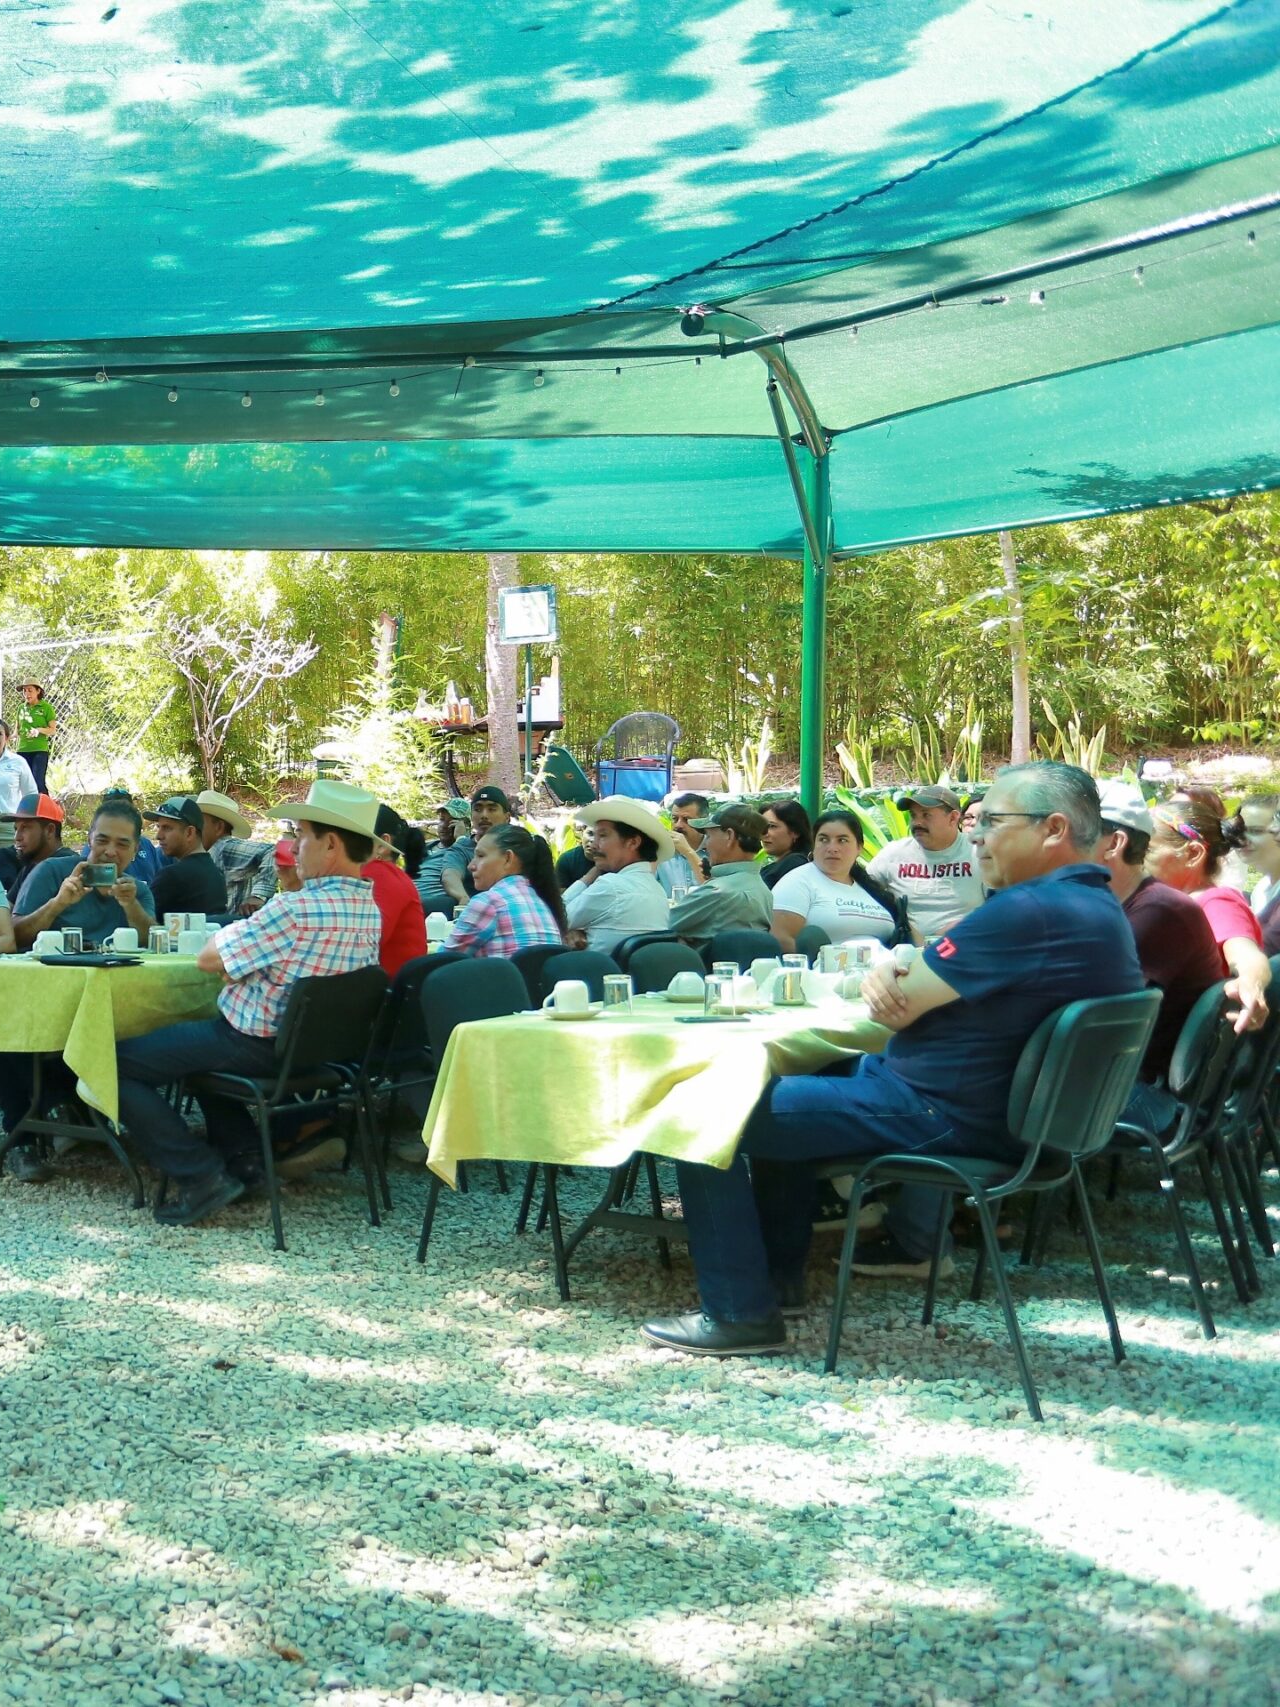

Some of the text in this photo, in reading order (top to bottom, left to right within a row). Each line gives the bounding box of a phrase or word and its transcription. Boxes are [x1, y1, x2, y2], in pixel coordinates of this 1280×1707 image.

[898, 862, 972, 879] HOLLISTER
[170, 918, 180, 936] 2
[834, 952, 848, 970] 1
